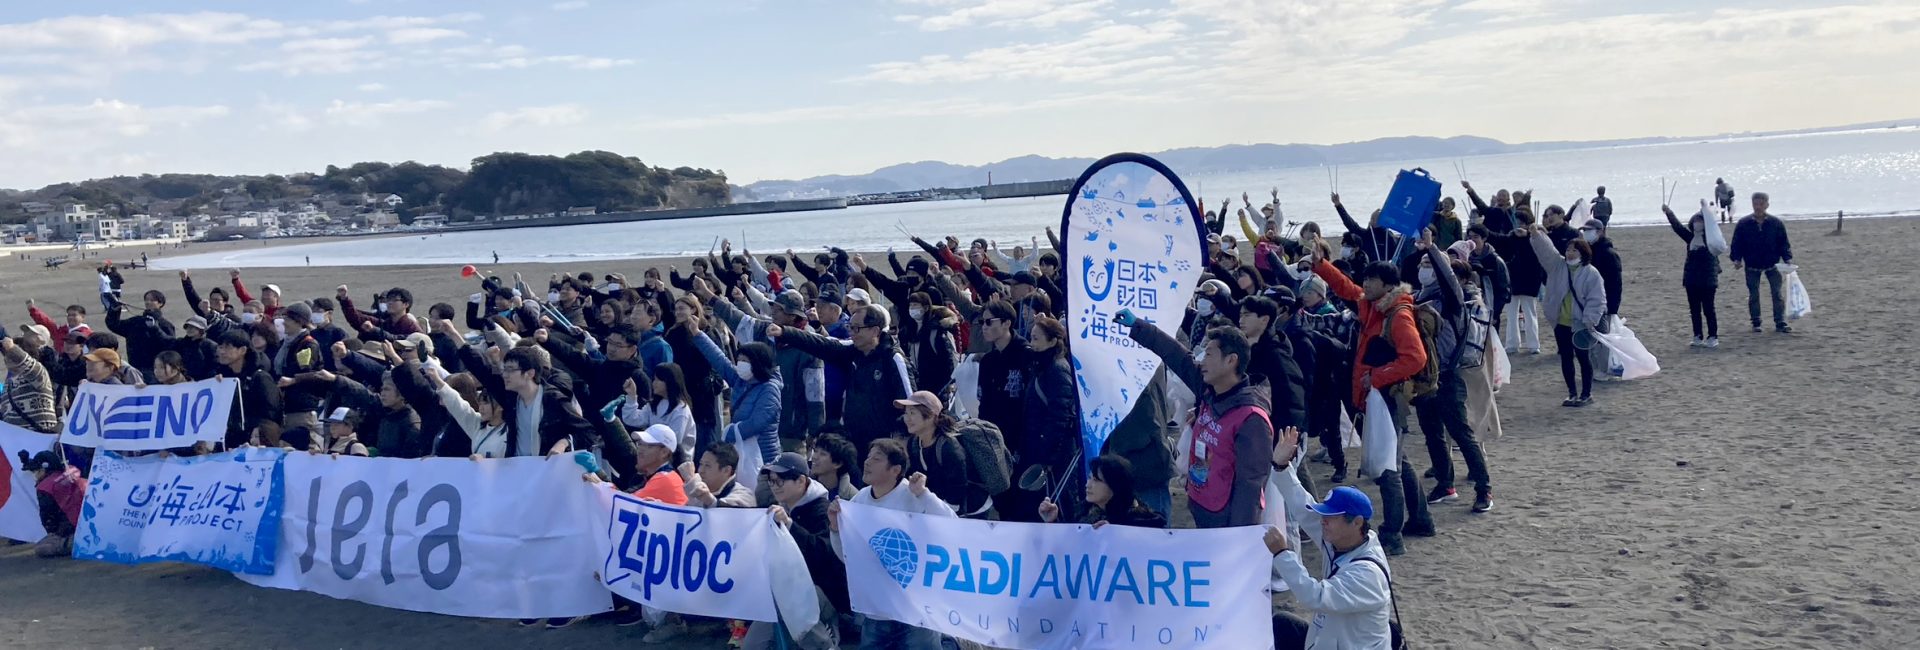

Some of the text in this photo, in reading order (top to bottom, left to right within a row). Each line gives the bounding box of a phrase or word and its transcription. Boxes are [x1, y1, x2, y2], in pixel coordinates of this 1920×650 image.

[1117, 259, 1156, 283] 日本
[1117, 284, 1157, 309] 財団
[1110, 335, 1142, 348] PROJ
[69, 388, 213, 439] UYENO
[618, 509, 734, 601] Ziploc
[923, 544, 1210, 607] PADI AWARE
